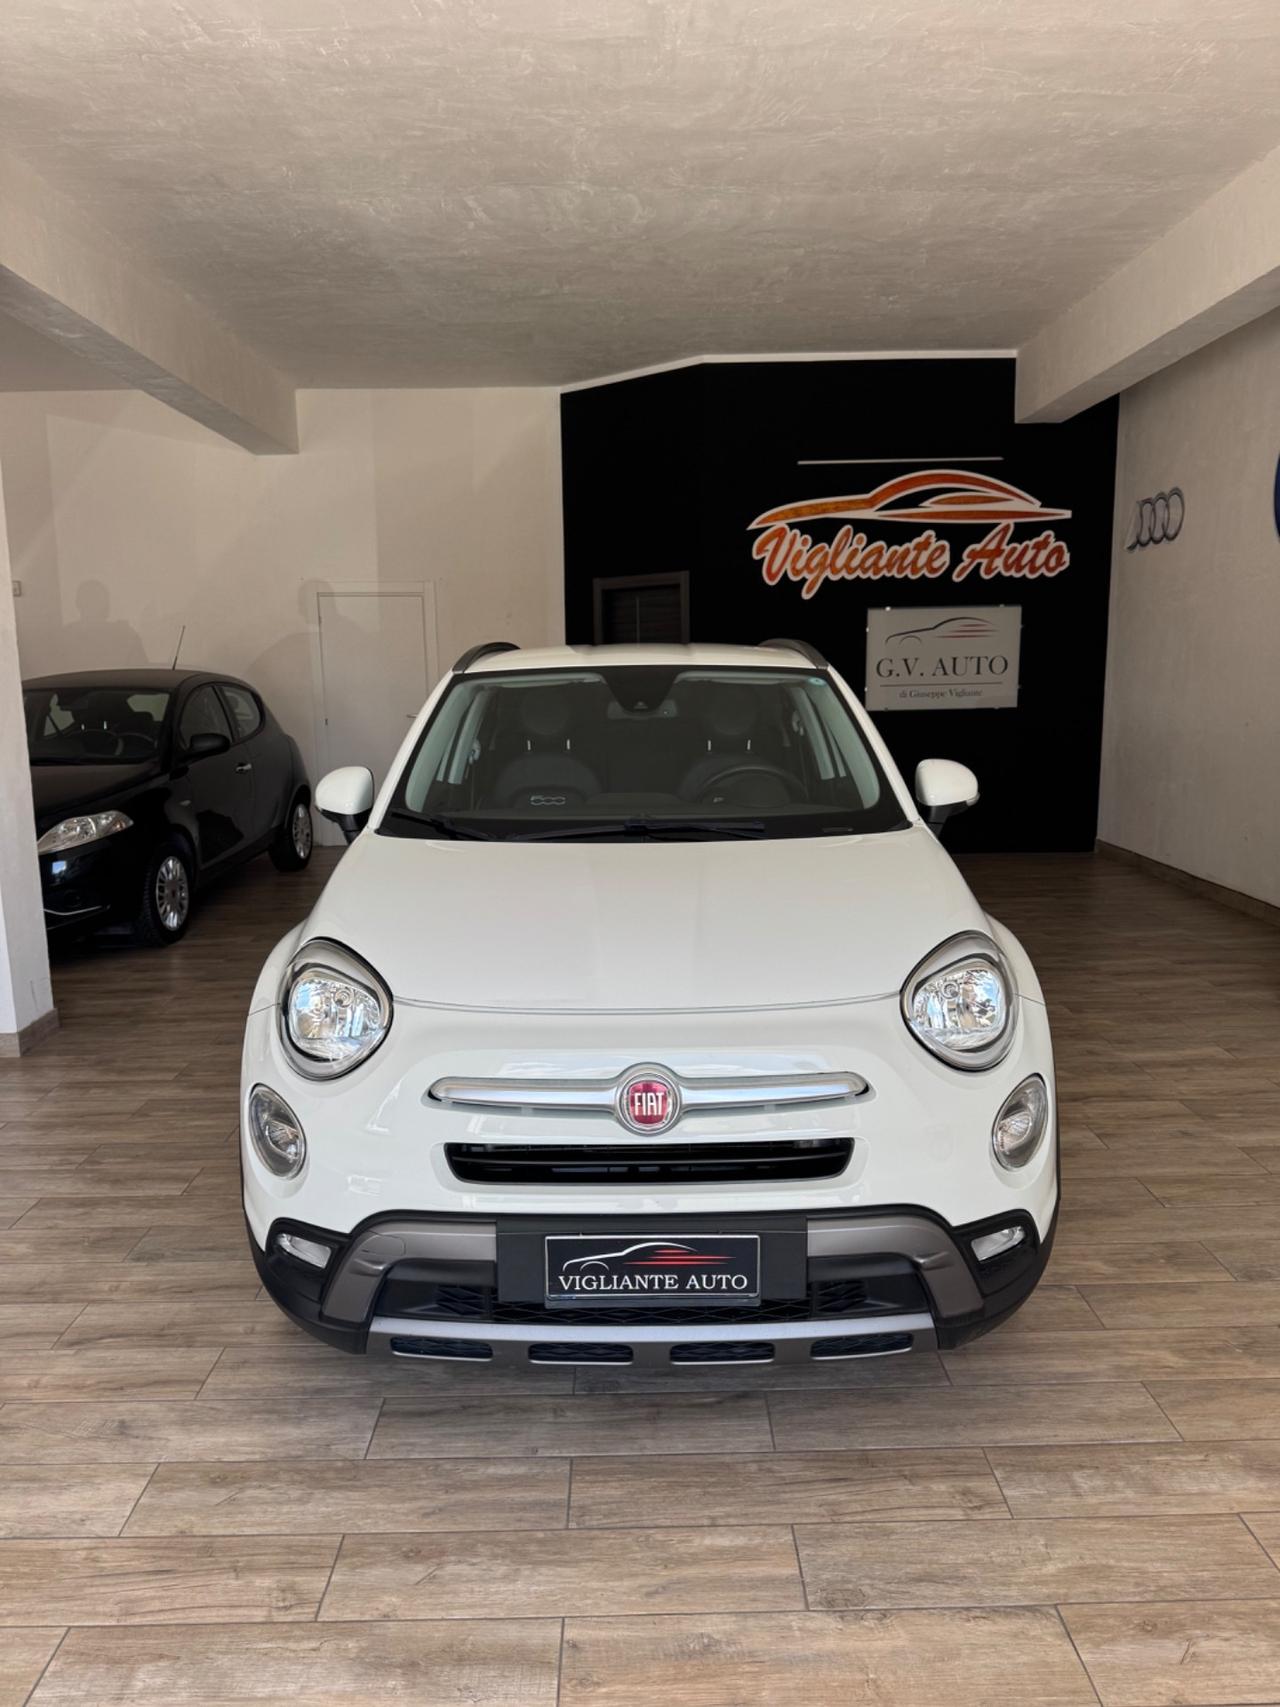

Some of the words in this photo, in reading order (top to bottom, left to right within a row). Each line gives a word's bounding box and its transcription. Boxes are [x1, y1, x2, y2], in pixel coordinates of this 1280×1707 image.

[751, 523, 950, 600] Vigliante
[952, 520, 1070, 582] Auto
[876, 656, 924, 678] G.V.
[932, 655, 1009, 677] AUTO
[909, 688, 945, 699] Giuseppe
[949, 688, 982, 698] Vigliante
[634, 1092, 665, 1116] FIAT
[558, 1274, 679, 1291] VIGLIANTE
[685, 1273, 748, 1290] AUTO
